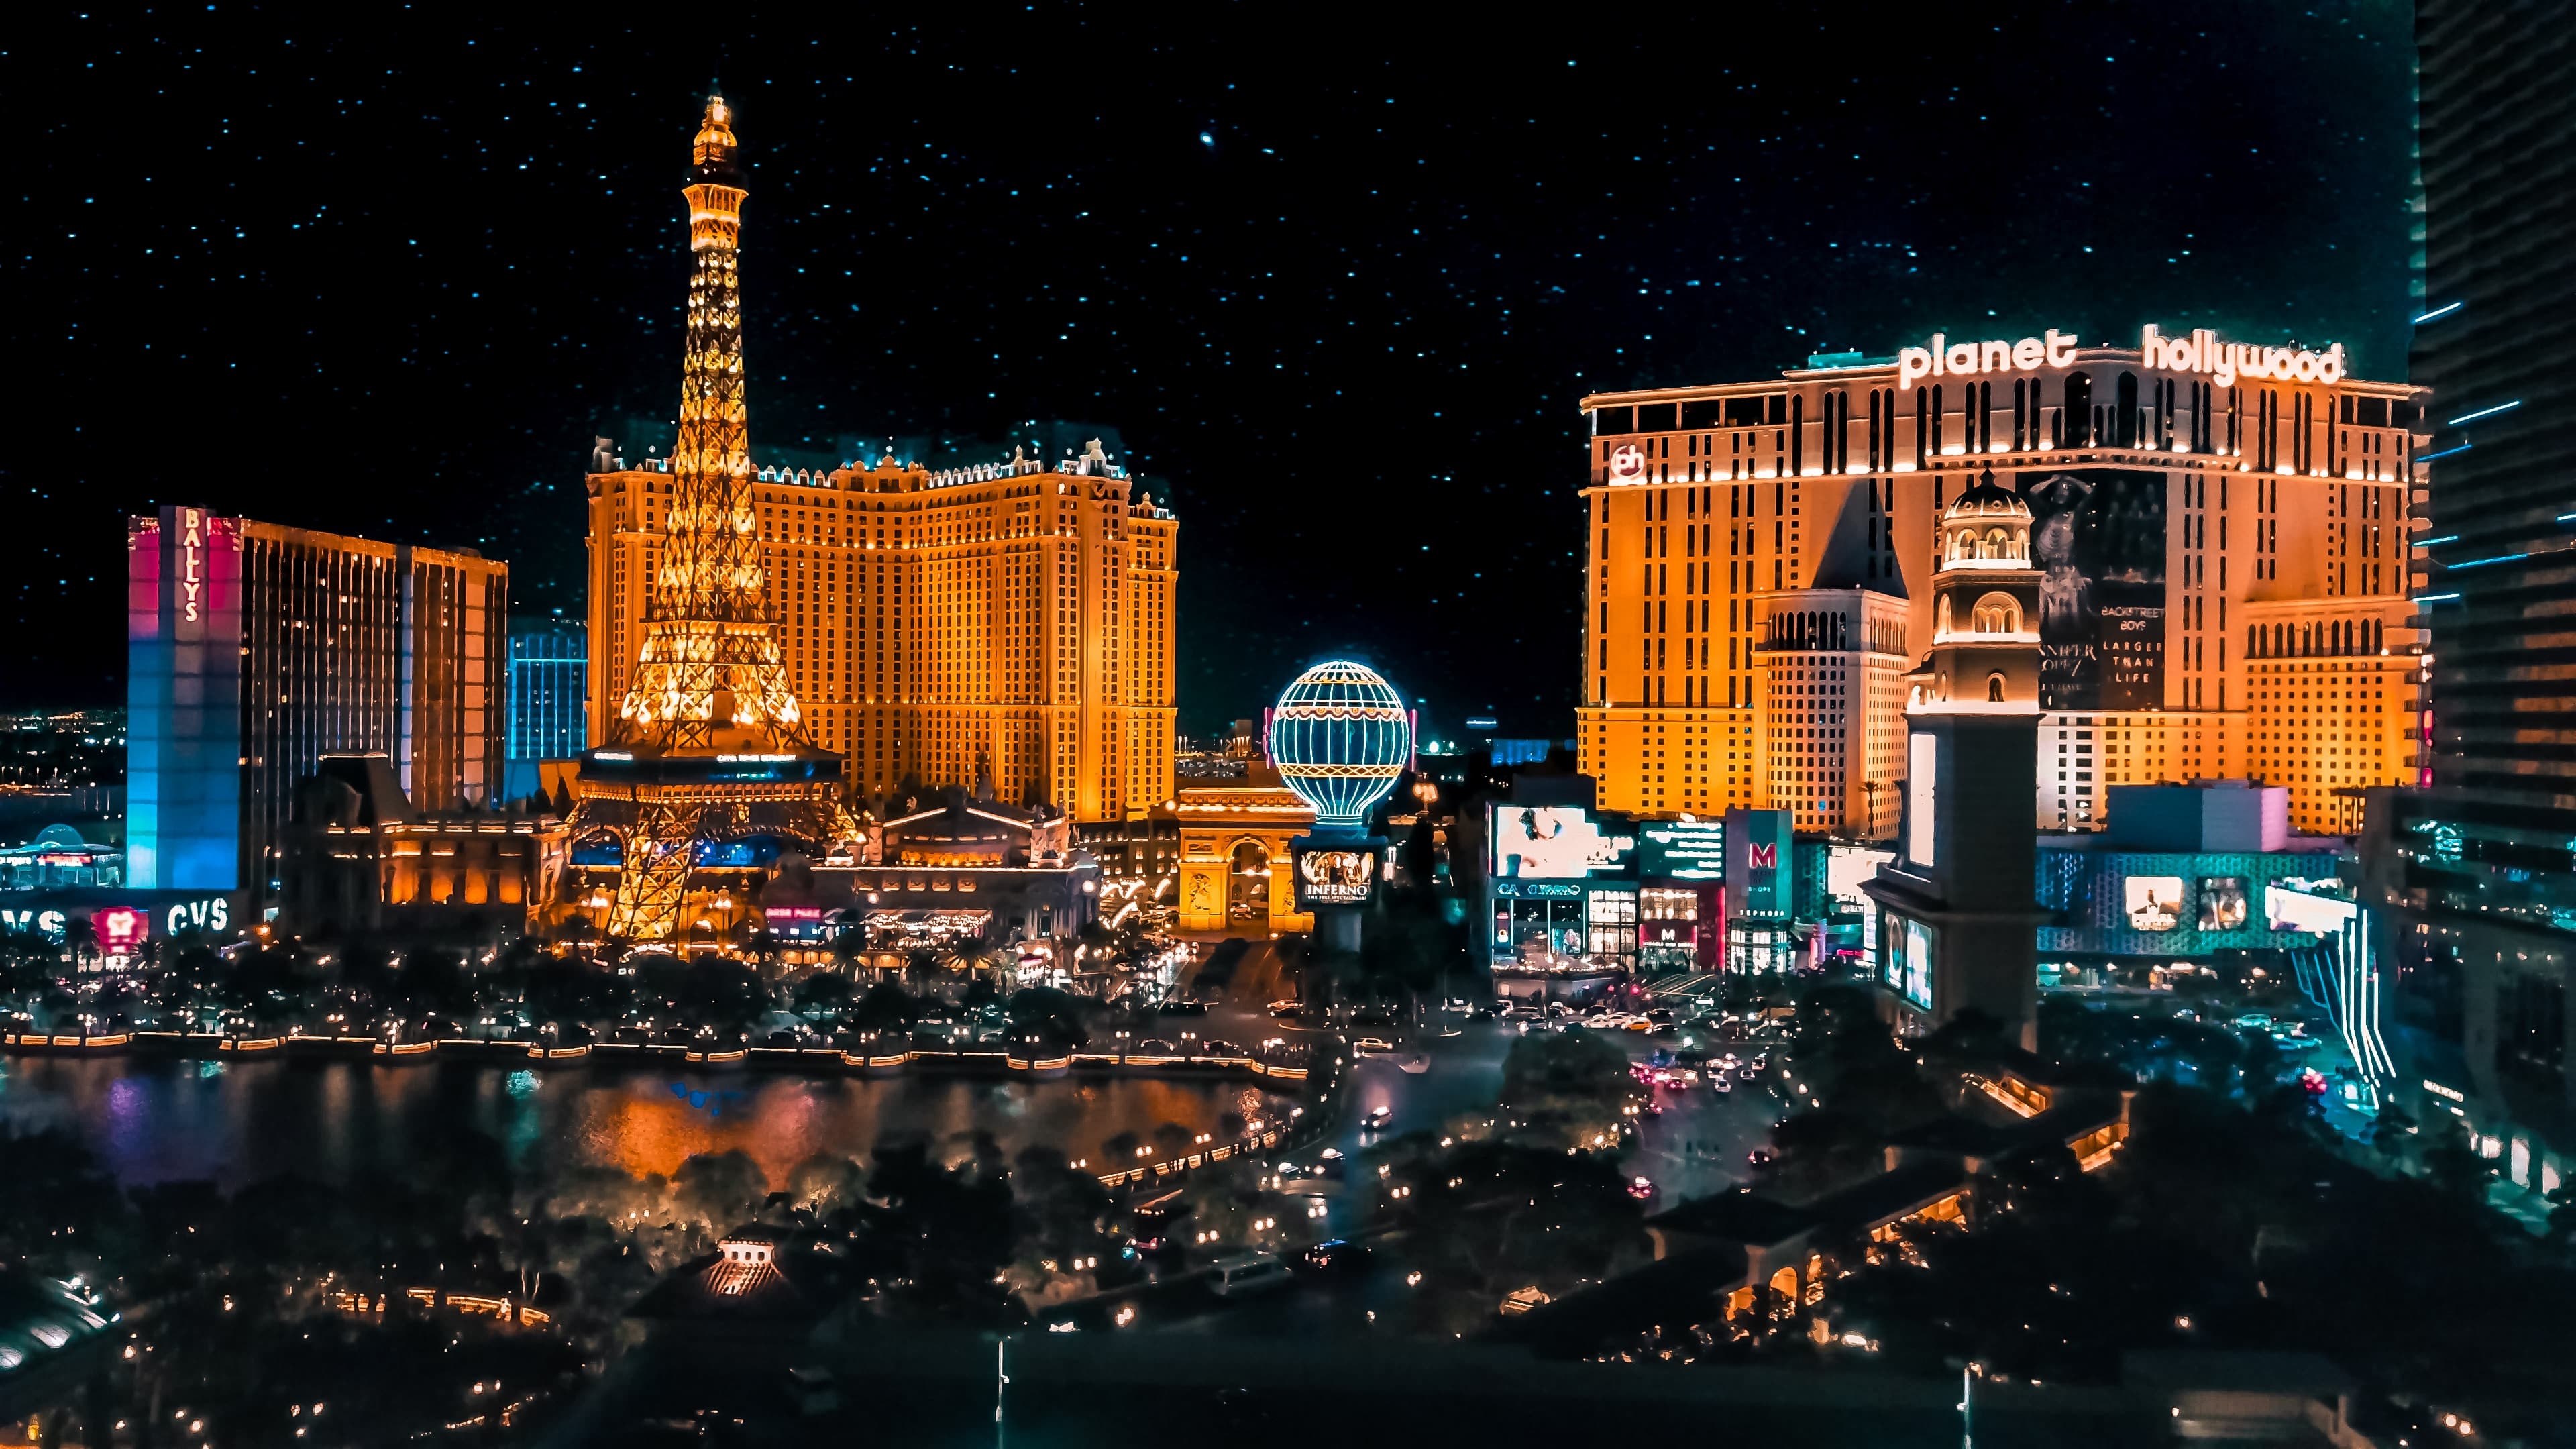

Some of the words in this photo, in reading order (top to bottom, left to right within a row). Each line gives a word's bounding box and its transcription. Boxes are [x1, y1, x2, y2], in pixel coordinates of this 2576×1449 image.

[1899, 329, 2078, 390] planet
[2143, 323, 2343, 388] hollywood
[2101, 606, 2164, 619] BACKSTREET
[2120, 620, 2146, 631] BOYS
[2103, 641, 2162, 652] LARGER
[2113, 656, 2154, 668] THAN
[2116, 672, 2150, 684] LIFE
[1748, 842, 1777, 869] M
[1307, 883, 1368, 896] INFERNO
[167, 898, 229, 937] CVS
[1739, 909, 1785, 917] SEPHORA
[1662, 928, 1675, 941] M
